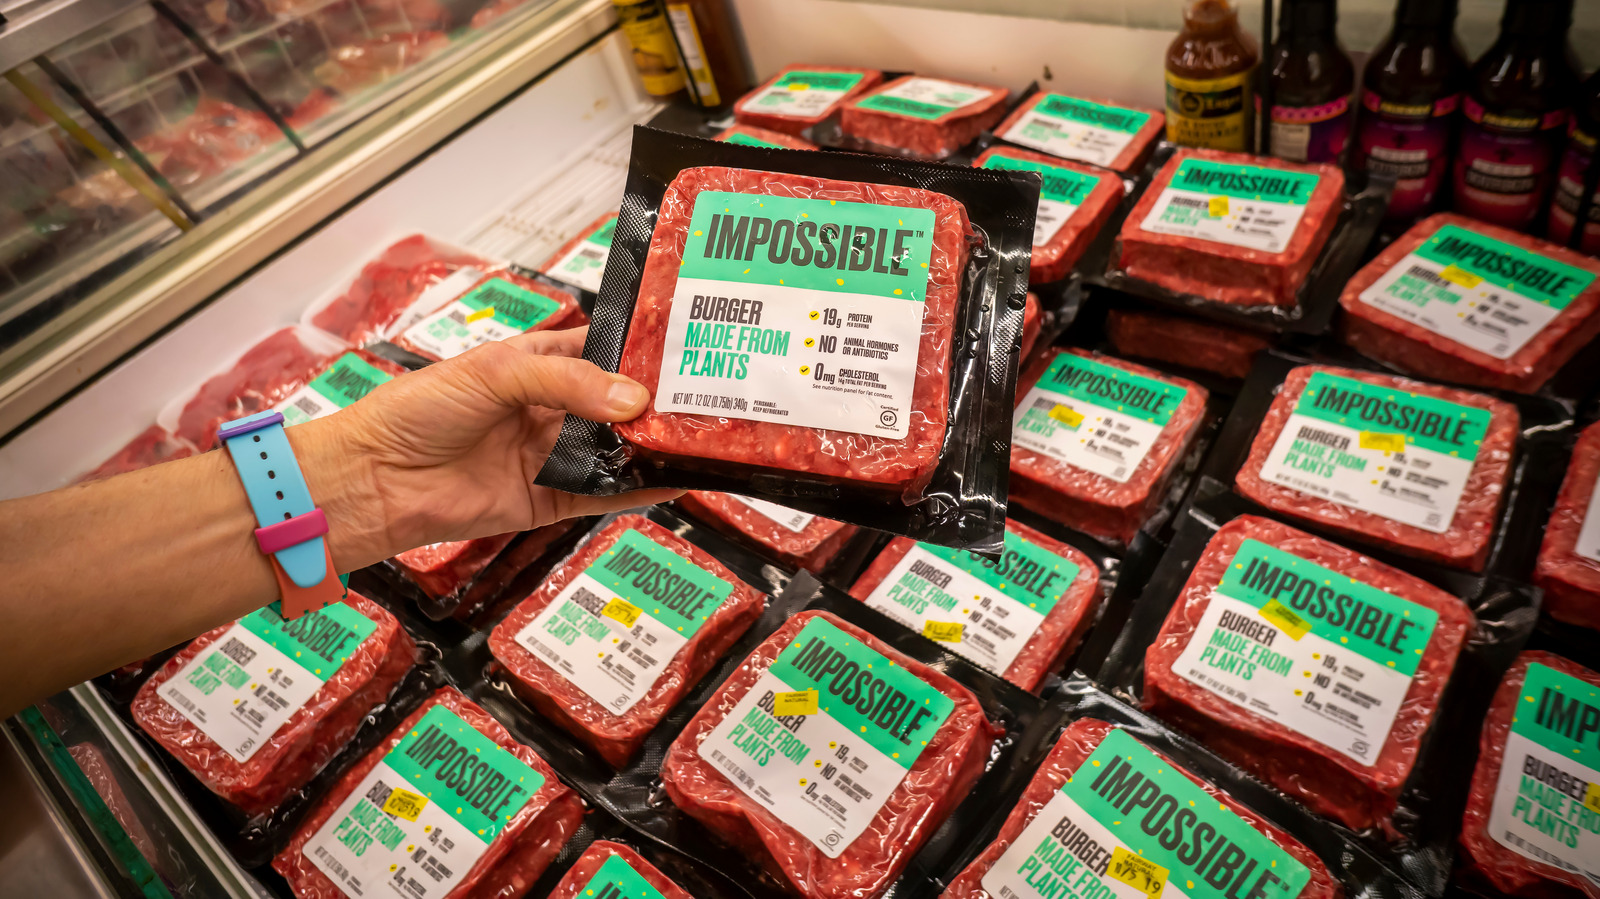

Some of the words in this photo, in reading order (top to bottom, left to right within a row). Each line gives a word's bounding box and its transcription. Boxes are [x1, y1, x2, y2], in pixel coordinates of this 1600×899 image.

[1183, 167, 1304, 197] IMPOSSIBLE
[704, 213, 913, 276] IMPOSSIBLE
[1433, 234, 1572, 298] IMPOSSIBLE
[690, 295, 763, 325] BURGER
[848, 313, 872, 323] PROTEIN
[684, 322, 736, 350] MADE
[737, 326, 791, 356] FROM
[818, 335, 837, 353] NO
[842, 346, 851, 355] OR
[852, 348, 889, 360] ANTIBIOTICS
[844, 337, 865, 348] ANIMAL
[866, 340, 899, 352] HORMONES
[679, 350, 750, 380] PLANTS
[839, 369, 880, 382] CHOLESTEROL
[672, 393, 684, 404] NET
[684, 393, 693, 405] WT.
[696, 394, 702, 406] 12
[702, 395, 712, 406] OZ
[733, 398, 748, 412] 340g
[871, 382, 887, 390] SERVING
[874, 392, 894, 400] content.
[1052, 364, 1171, 415] IMPOSSIBLE
[1313, 385, 1472, 447] IMPOSSIBLE
[1291, 438, 1330, 459] MADE
[1330, 449, 1368, 472] FROM
[1297, 426, 1350, 451] BURGER
[1283, 452, 1336, 479] PLANTS
[604, 543, 715, 621] IMPOSSIBLE
[910, 560, 952, 589] BURGER
[887, 584, 929, 614] PLANTS
[898, 572, 931, 596] MADE
[925, 586, 958, 612] FROM
[1239, 557, 1415, 655] IMPOSSIBLE
[1218, 609, 1277, 647] BURGER
[1200, 646, 1256, 680] PLANTS
[1209, 628, 1252, 656] MADE
[1249, 644, 1294, 677] FROM
[790, 636, 933, 746] IMPOSSIBLE
[1313, 673, 1331, 689] NO
[726, 723, 775, 767] PLANTS
[742, 707, 781, 741] MADE
[771, 728, 811, 765] FROM
[404, 723, 524, 822] IMPOSSIBLE
[820, 763, 837, 780] NO
[332, 816, 374, 857] PLANTS
[1089, 754, 1280, 899] IMPOSSIBLE
[1512, 795, 1580, 849] PLANTS
[1034, 835, 1083, 883] MADE
